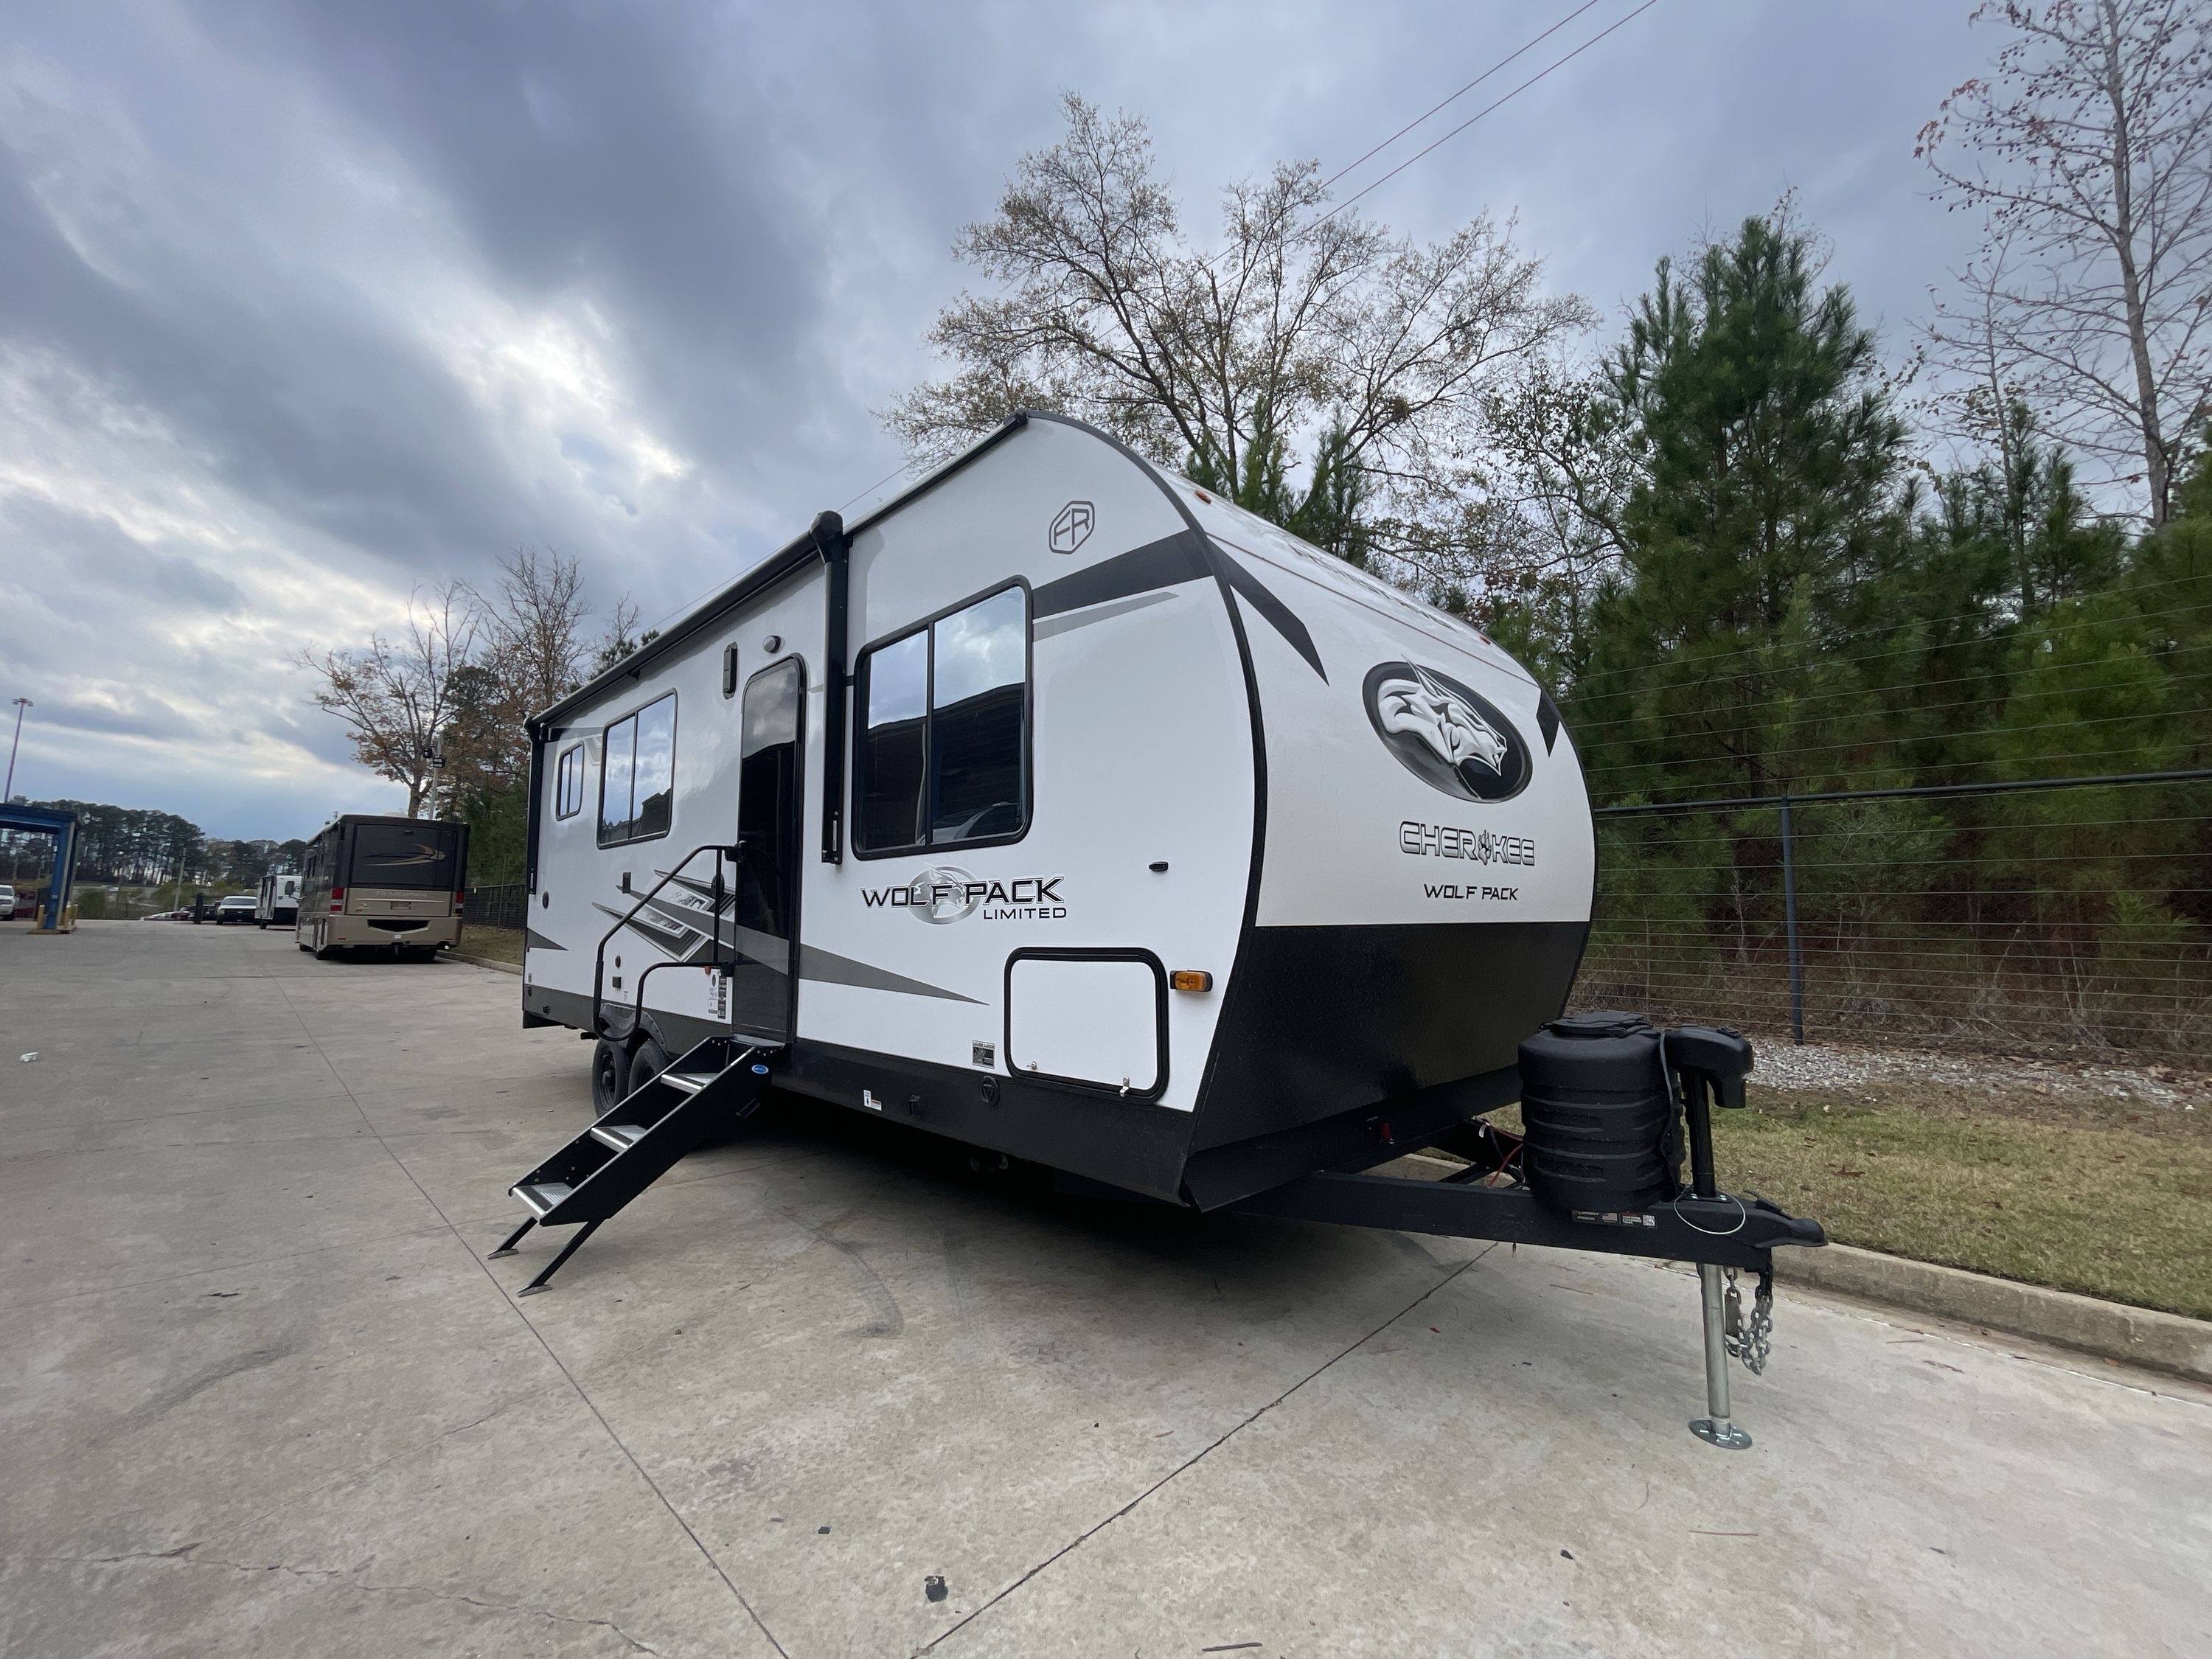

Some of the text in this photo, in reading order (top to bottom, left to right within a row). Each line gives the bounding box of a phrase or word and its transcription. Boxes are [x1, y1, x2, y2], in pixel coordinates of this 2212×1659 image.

[860, 875, 1065, 908] WOLF PACK
[1423, 883, 1518, 900] WOLF PACK
[983, 907, 1068, 920] LIMITED
